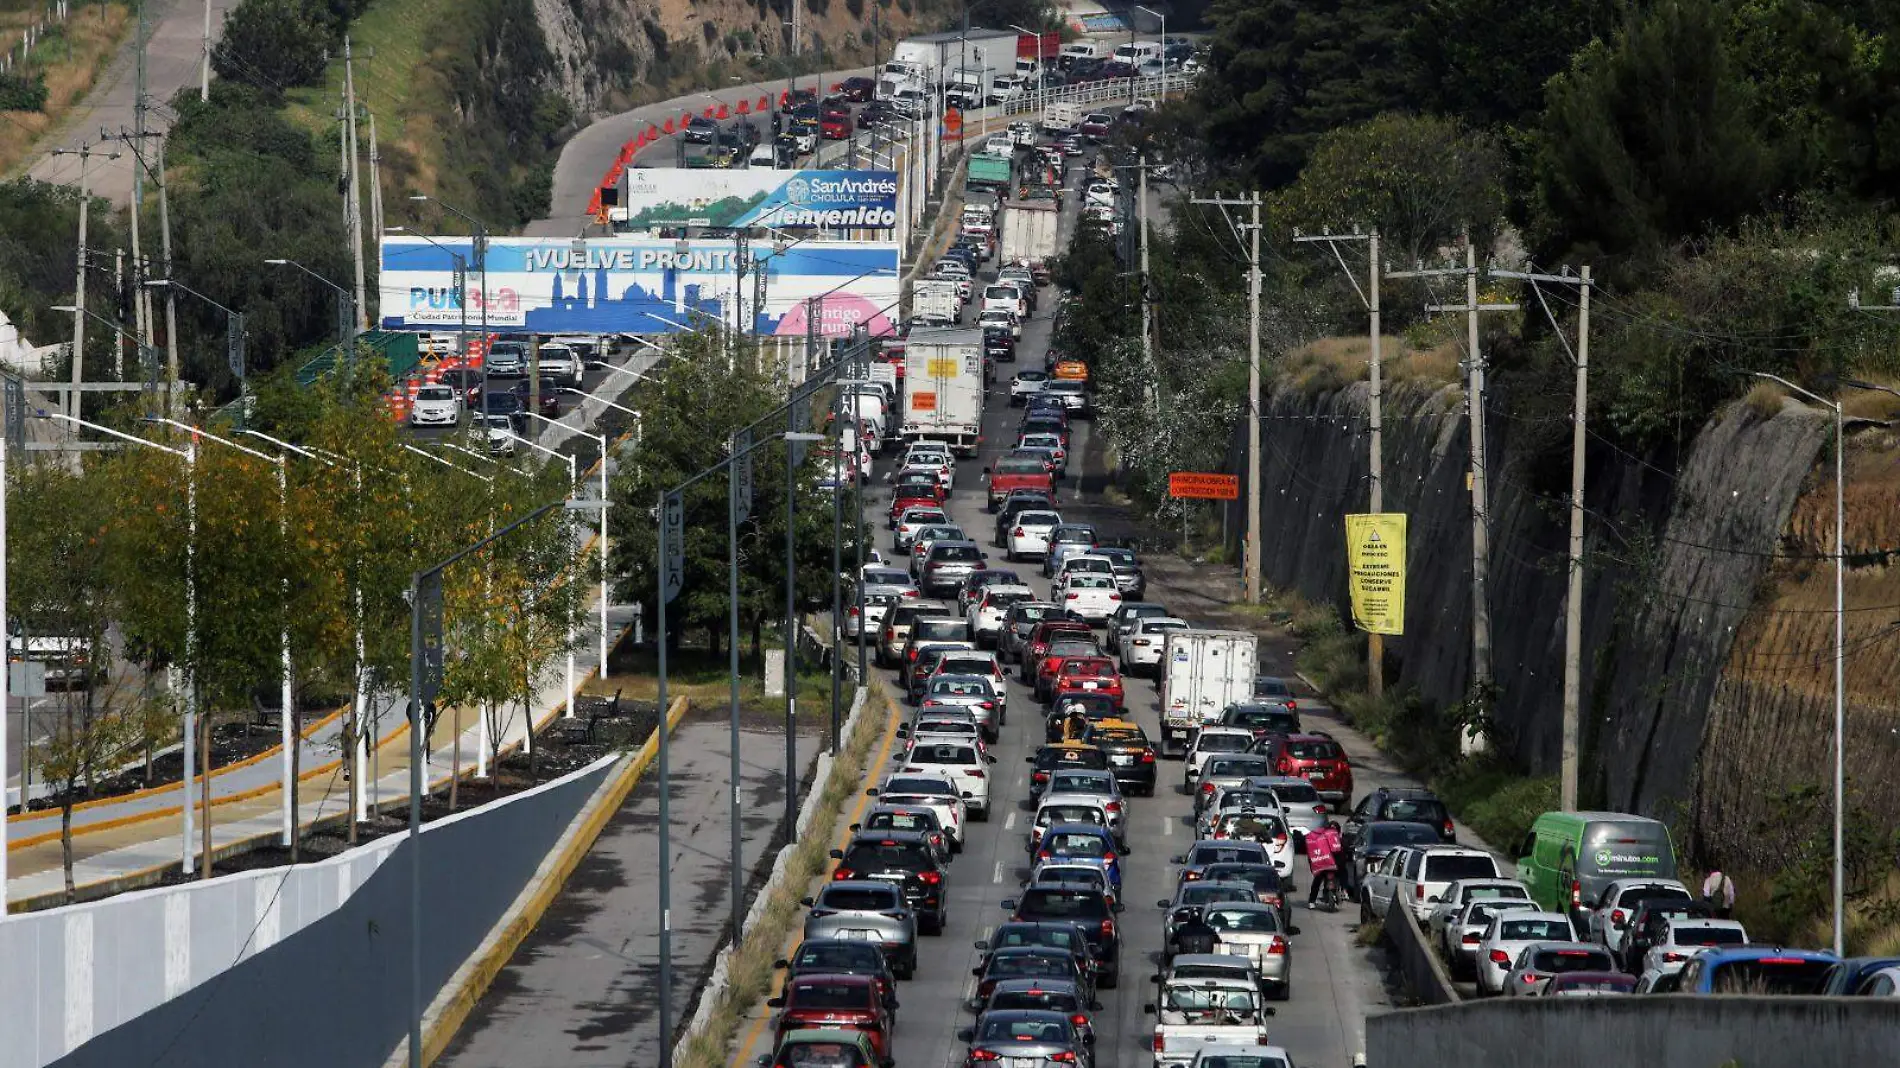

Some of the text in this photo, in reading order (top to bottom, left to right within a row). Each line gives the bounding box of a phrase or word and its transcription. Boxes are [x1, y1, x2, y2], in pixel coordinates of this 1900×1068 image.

[811, 194, 855, 202] CHOLULA
[526, 248, 635, 272] ¡VUELVE
[413, 312, 440, 321] Ciudad
[487, 313, 518, 321] Mundial
